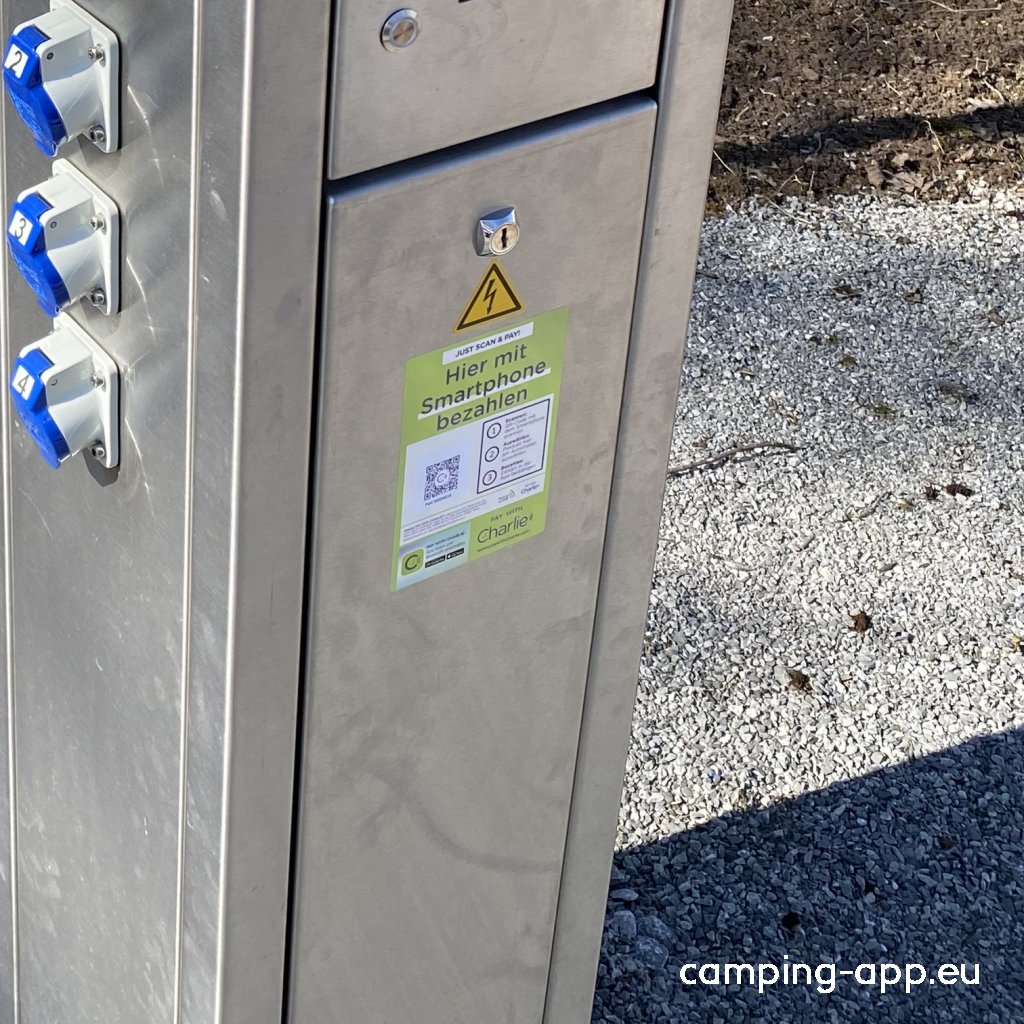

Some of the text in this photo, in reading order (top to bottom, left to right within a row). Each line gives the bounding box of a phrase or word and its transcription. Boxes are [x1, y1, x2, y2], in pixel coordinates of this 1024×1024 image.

[8, 50, 22, 72] 2
[15, 217, 26, 238] 3
[455, 346, 474, 358] JUST
[475, 339, 496, 352] SCAN
[505, 330, 520, 341] PAY!
[446, 344, 528, 385] Hier mit
[17, 375, 29, 397] 4
[421, 360, 546, 415] Smartphone
[437, 388, 528, 432] bezahlen
[490, 506, 523, 522] PAY WITH
[477, 516, 528, 544] Charlie
